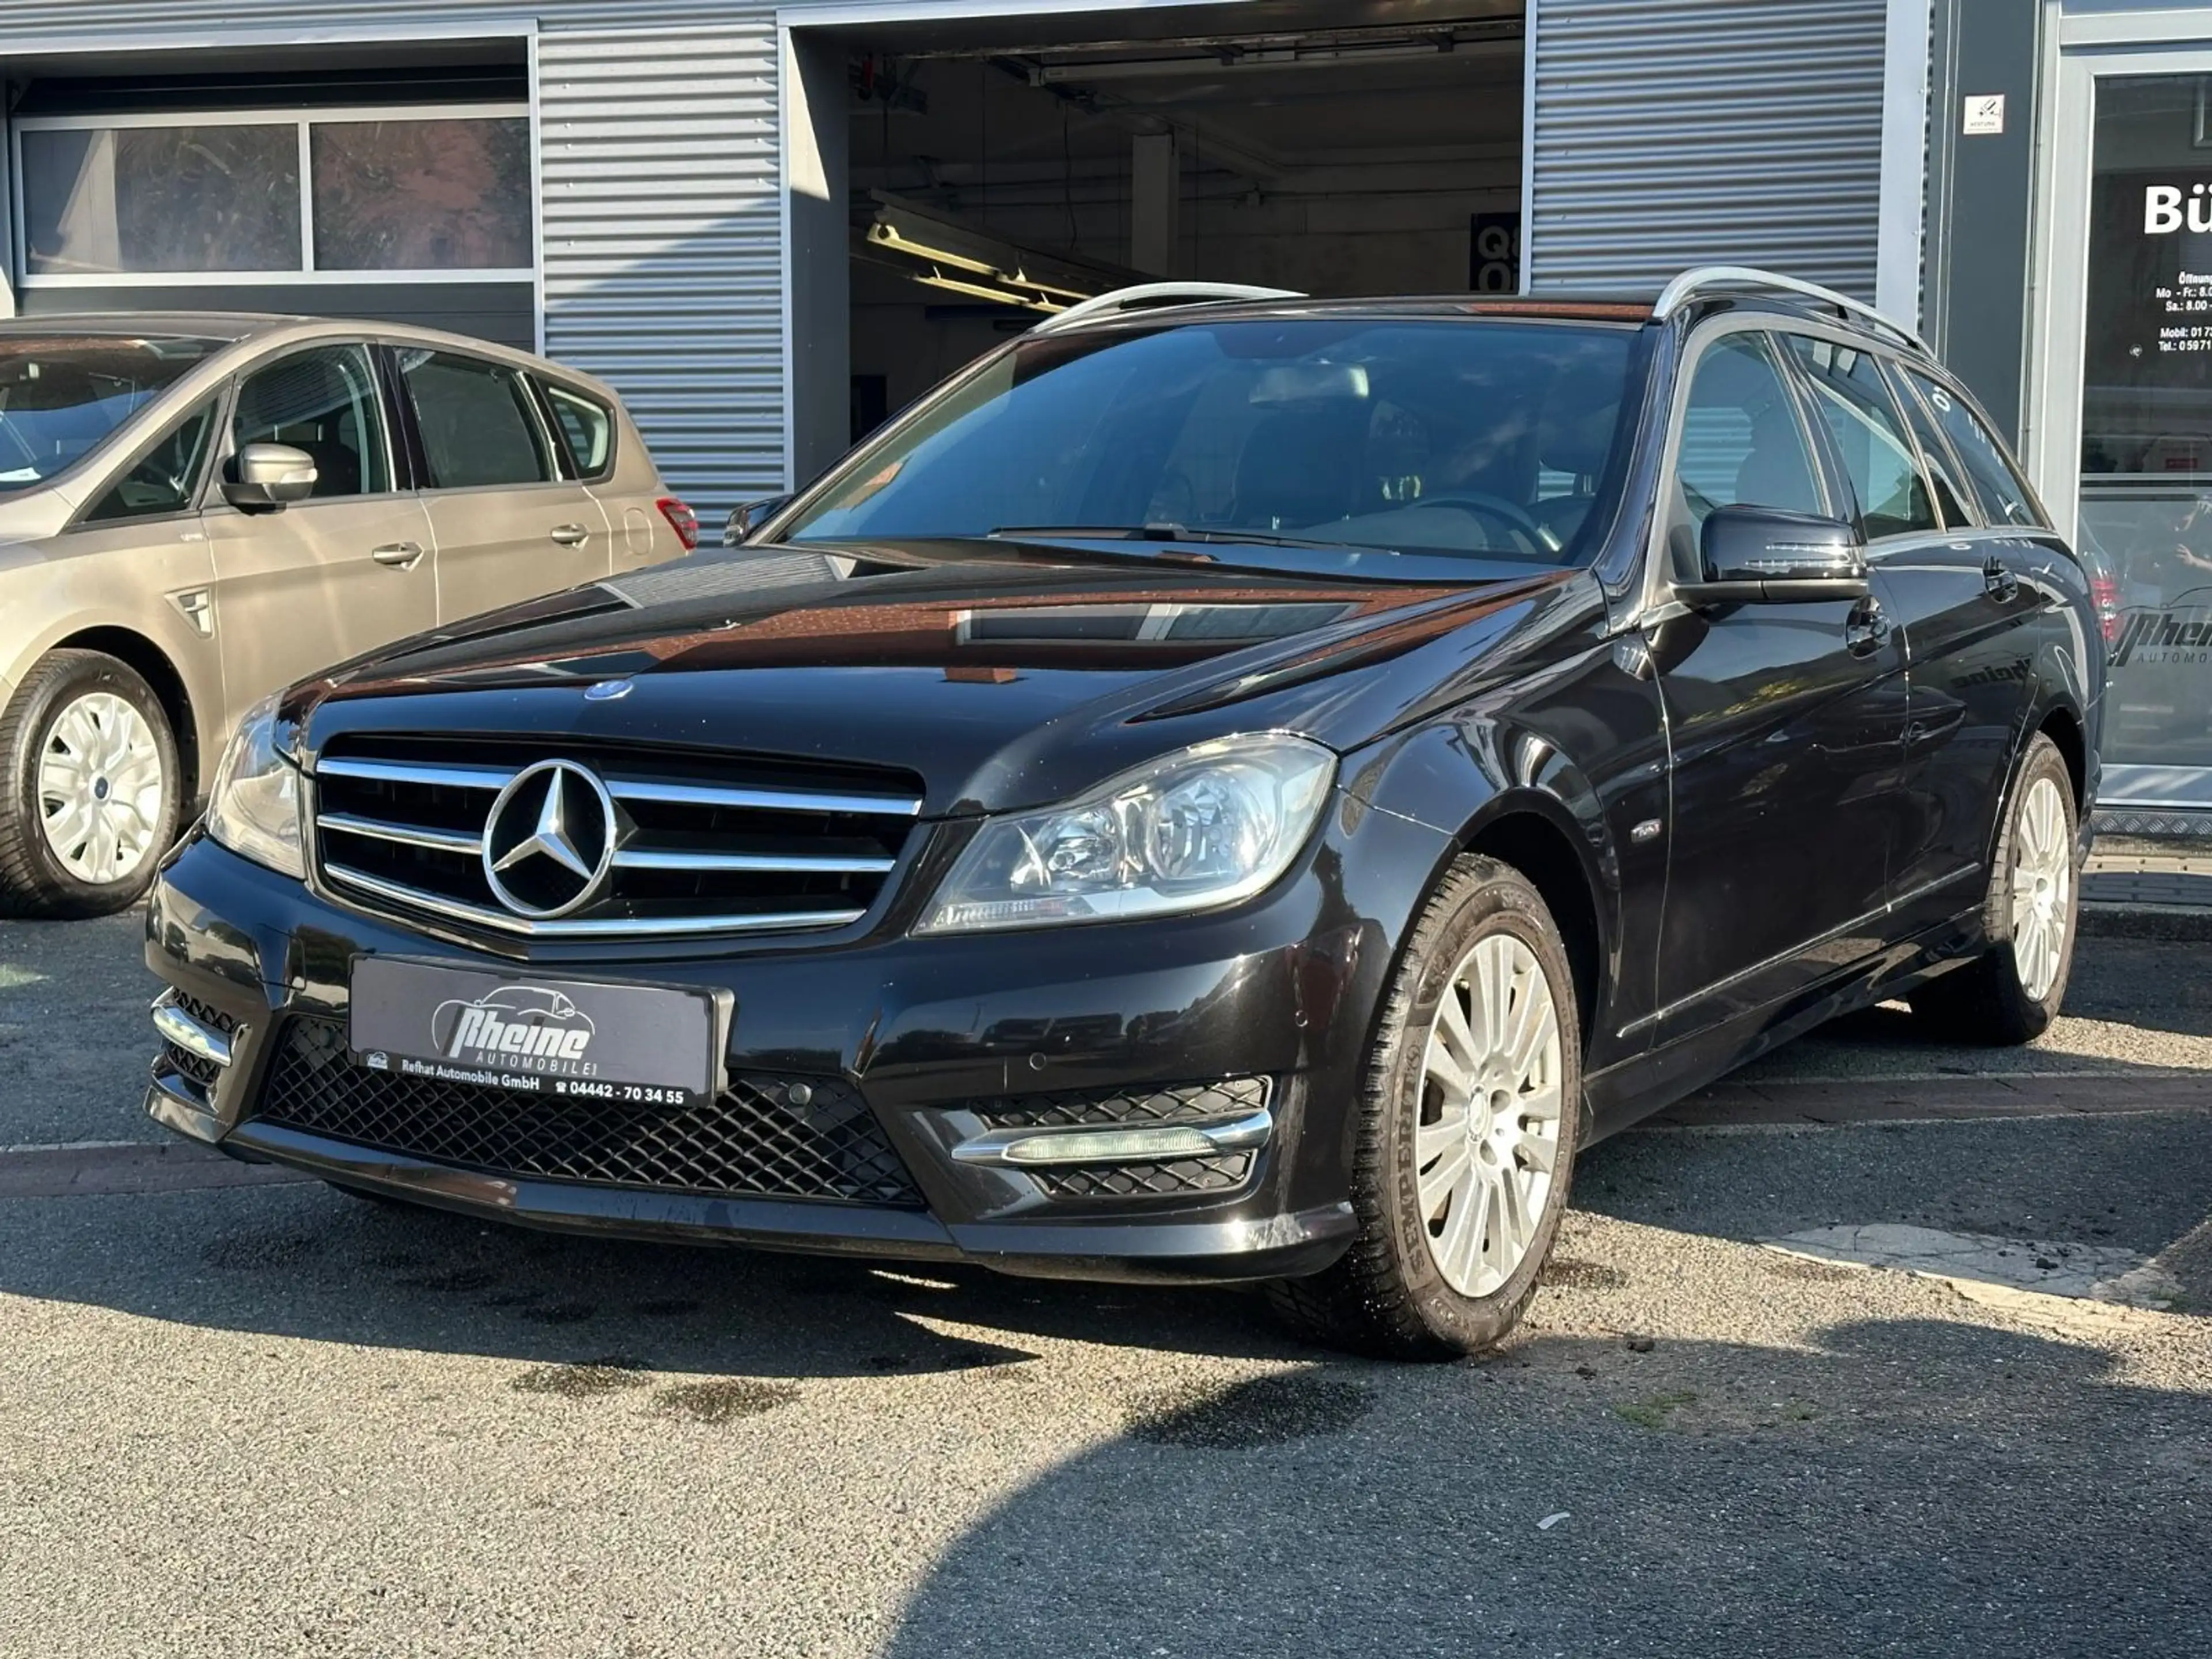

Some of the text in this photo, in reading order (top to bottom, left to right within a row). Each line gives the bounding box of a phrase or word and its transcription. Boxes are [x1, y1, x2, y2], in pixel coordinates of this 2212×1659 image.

[2144, 183, 2212, 234] Bü
[2186, 300, 2207, 310] 8.00
[2160, 327, 2188, 338] Mobil:
[2158, 340, 2177, 352] Tel.:
[435, 1065, 498, 1085] Automobile
[501, 1074, 540, 1090] GmbH
[570, 1081, 613, 1097] 04442
[624, 1086, 642, 1100] 70
[645, 1088, 662, 1103] 34
[666, 1090, 684, 1104] 55
